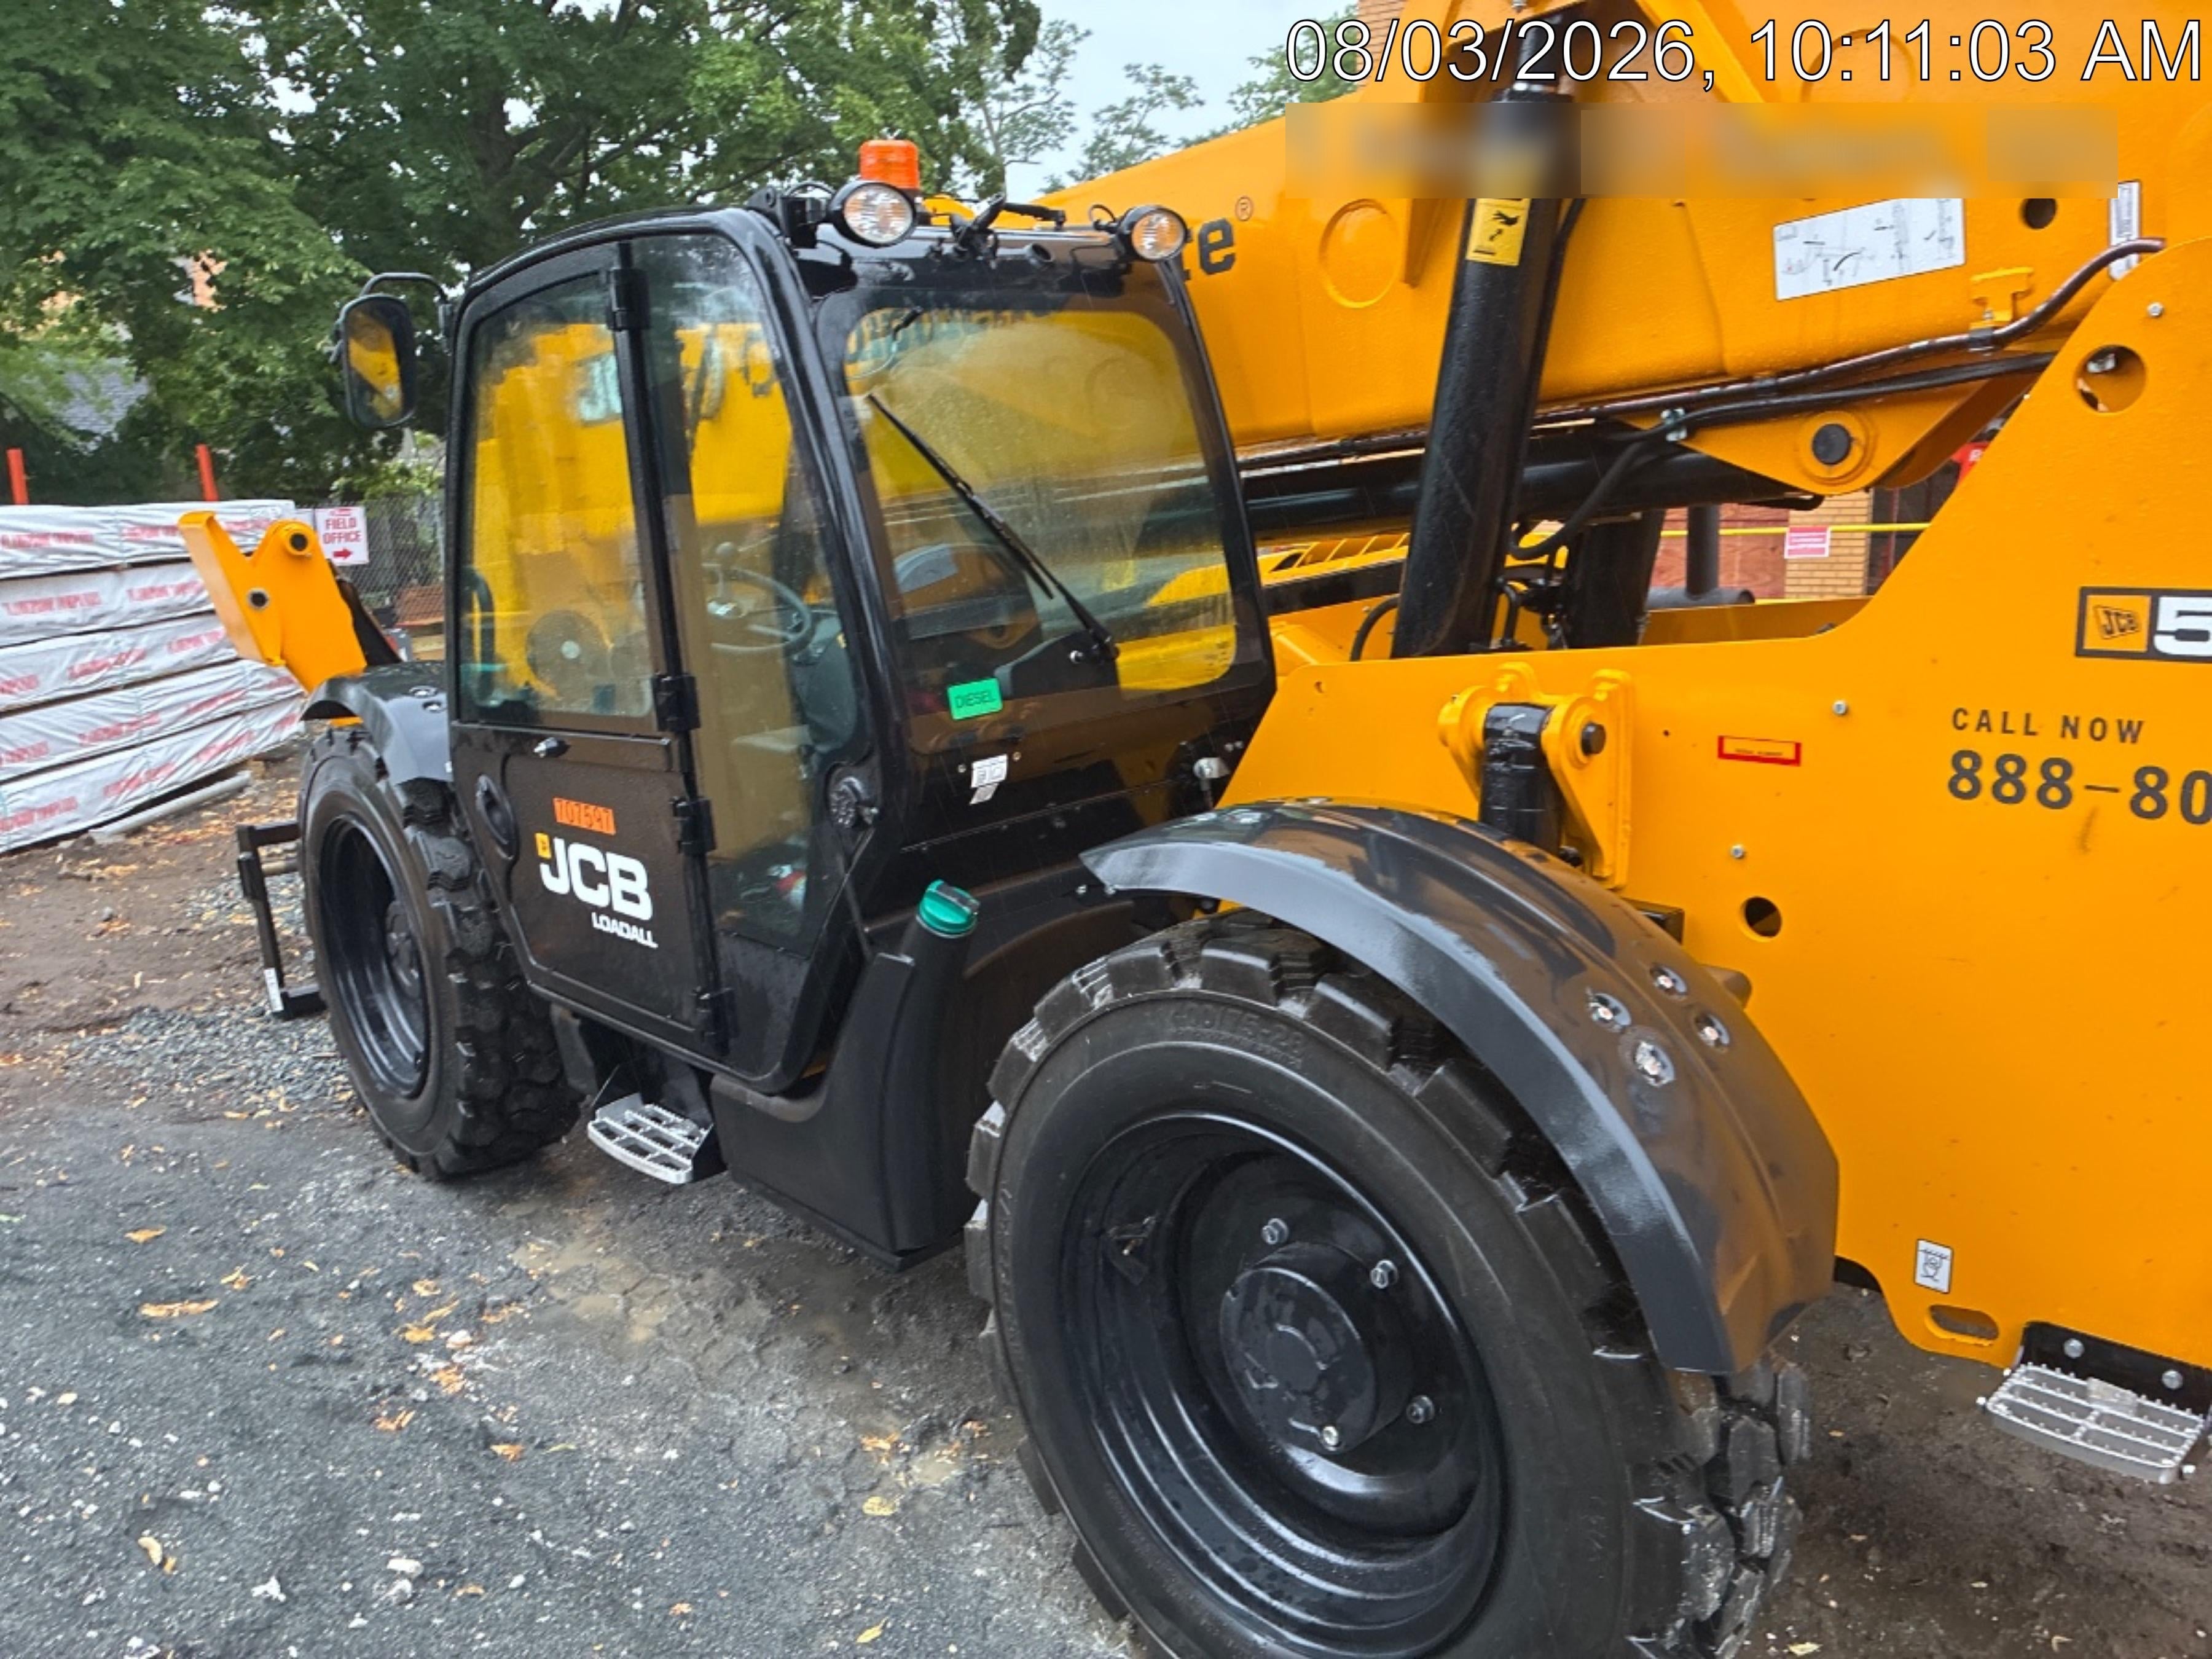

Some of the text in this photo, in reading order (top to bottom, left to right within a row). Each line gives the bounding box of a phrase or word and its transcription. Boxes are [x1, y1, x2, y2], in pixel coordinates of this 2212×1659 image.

[323, 531, 361, 544] OFFICE
[325, 517, 357, 530] FIELD
[954, 689, 997, 708] DIESEL
[1951, 707, 2144, 744] CALL NOW
[539, 837, 653, 920] JCB
[590, 912, 659, 949] LOADALL
